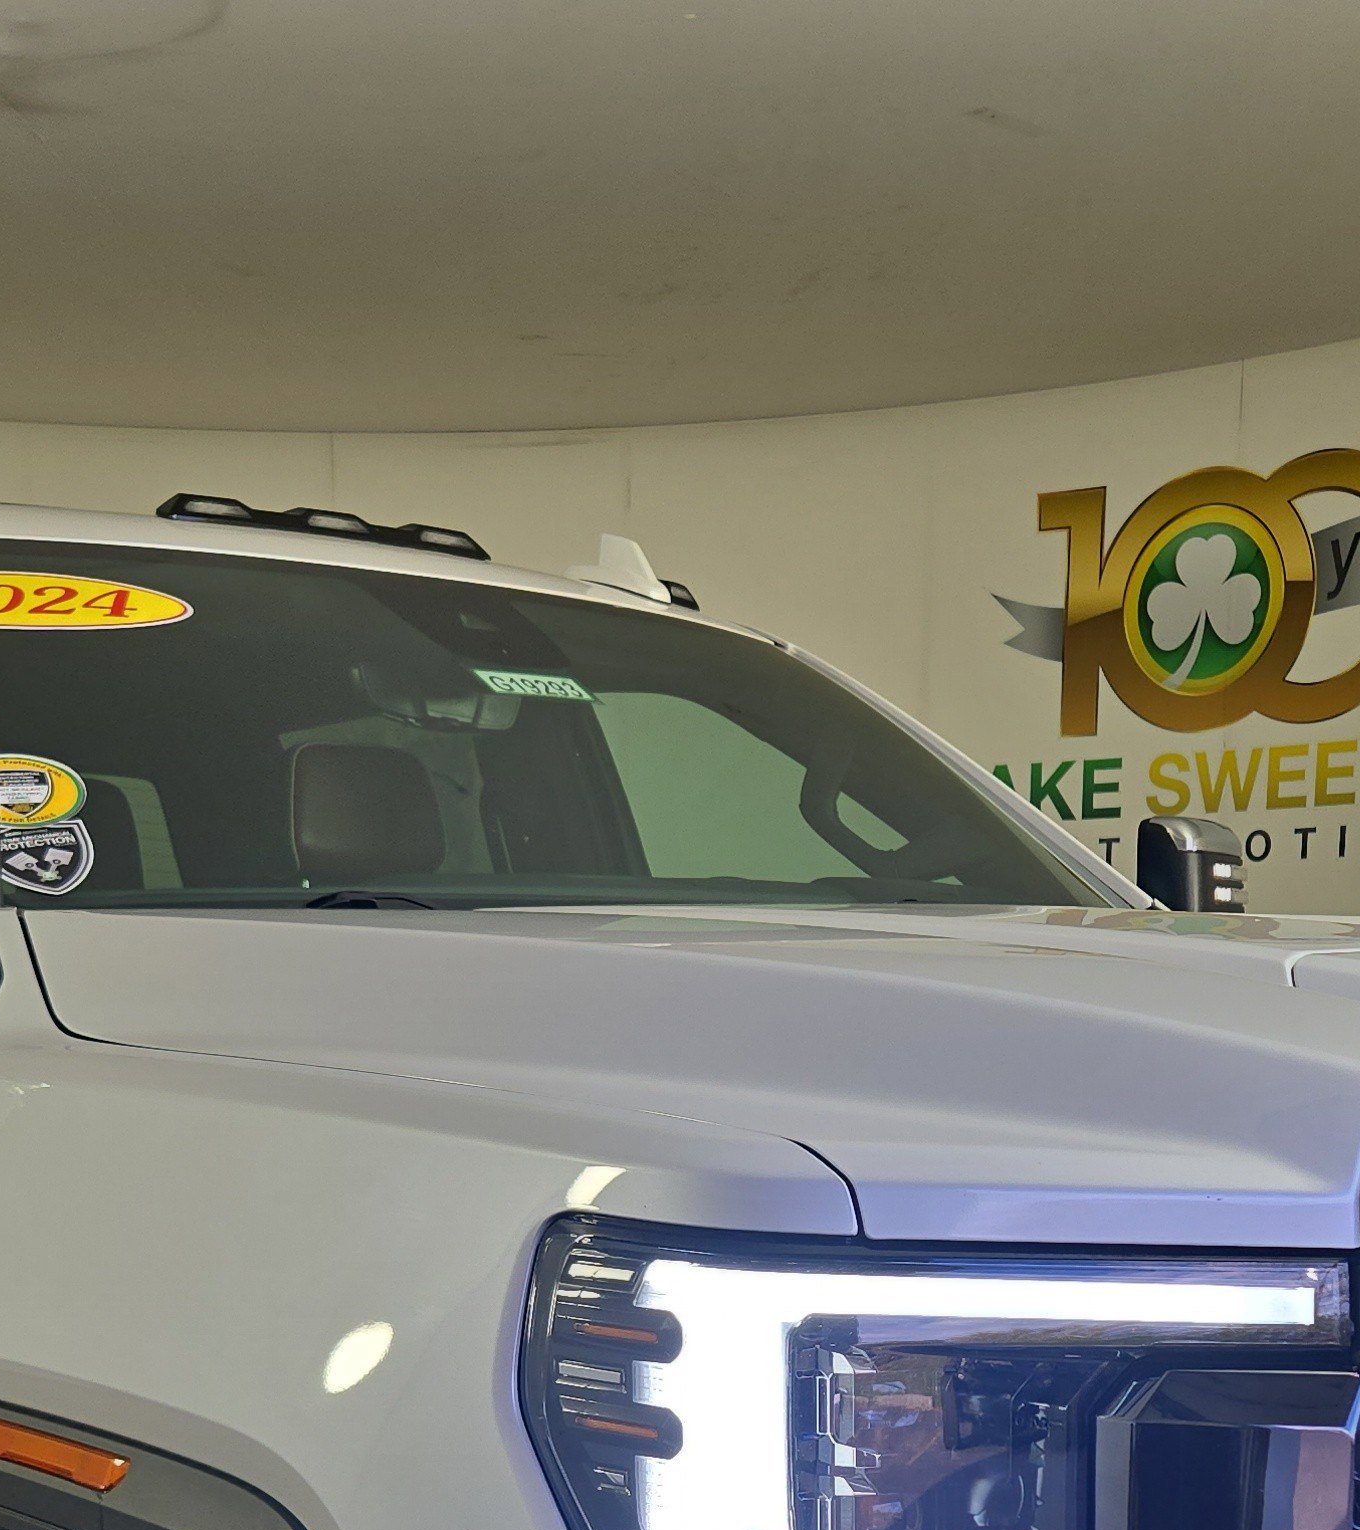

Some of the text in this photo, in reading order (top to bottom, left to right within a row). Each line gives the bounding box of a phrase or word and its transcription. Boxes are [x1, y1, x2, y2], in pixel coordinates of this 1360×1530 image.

[488, 675, 584, 698] G19293
[993, 757, 1123, 821] KE
[0, 836, 78, 852] ROTECTION
